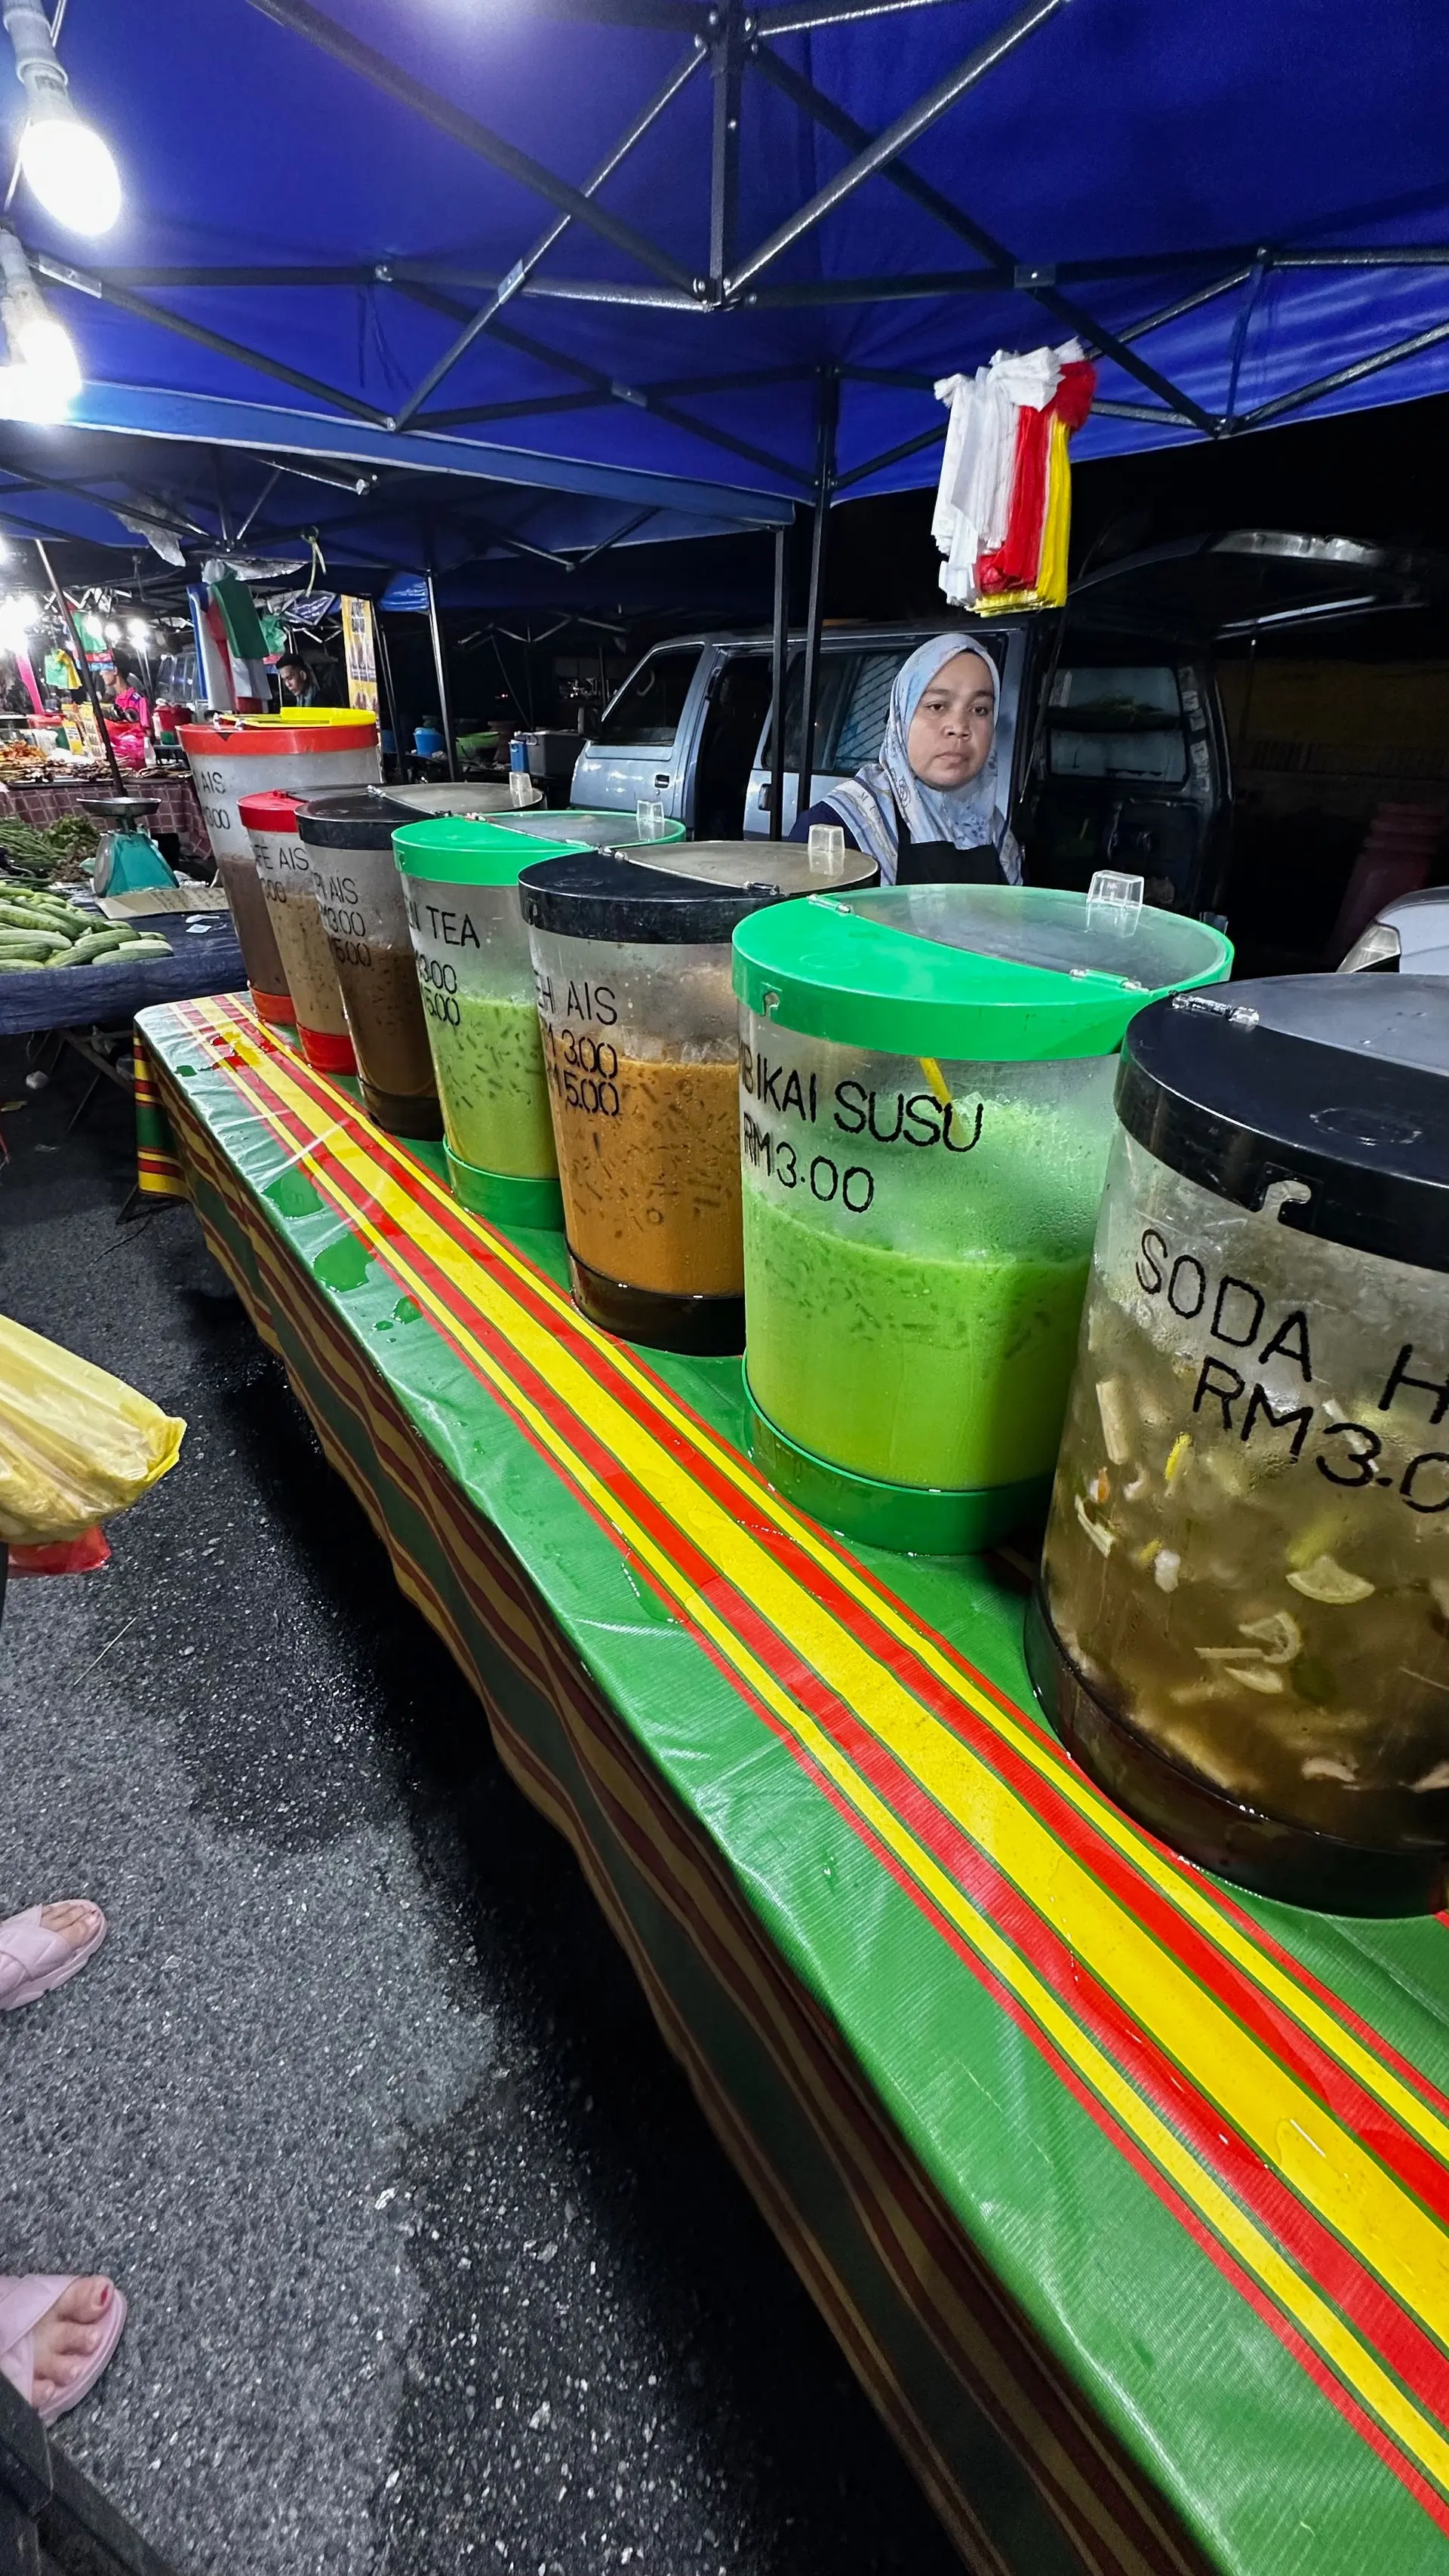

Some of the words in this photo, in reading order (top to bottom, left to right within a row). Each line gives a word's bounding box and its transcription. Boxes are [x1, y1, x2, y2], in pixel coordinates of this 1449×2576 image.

[278, 847, 309, 871] AIS
[329, 876, 358, 905] AIS
[426, 905, 481, 949] TEA
[567, 980, 618, 1026] AIS
[833, 1079, 984, 1153] SUSU
[743, 1111, 875, 1214] RM3.00
[1135, 1228, 1313, 1383] SODA
